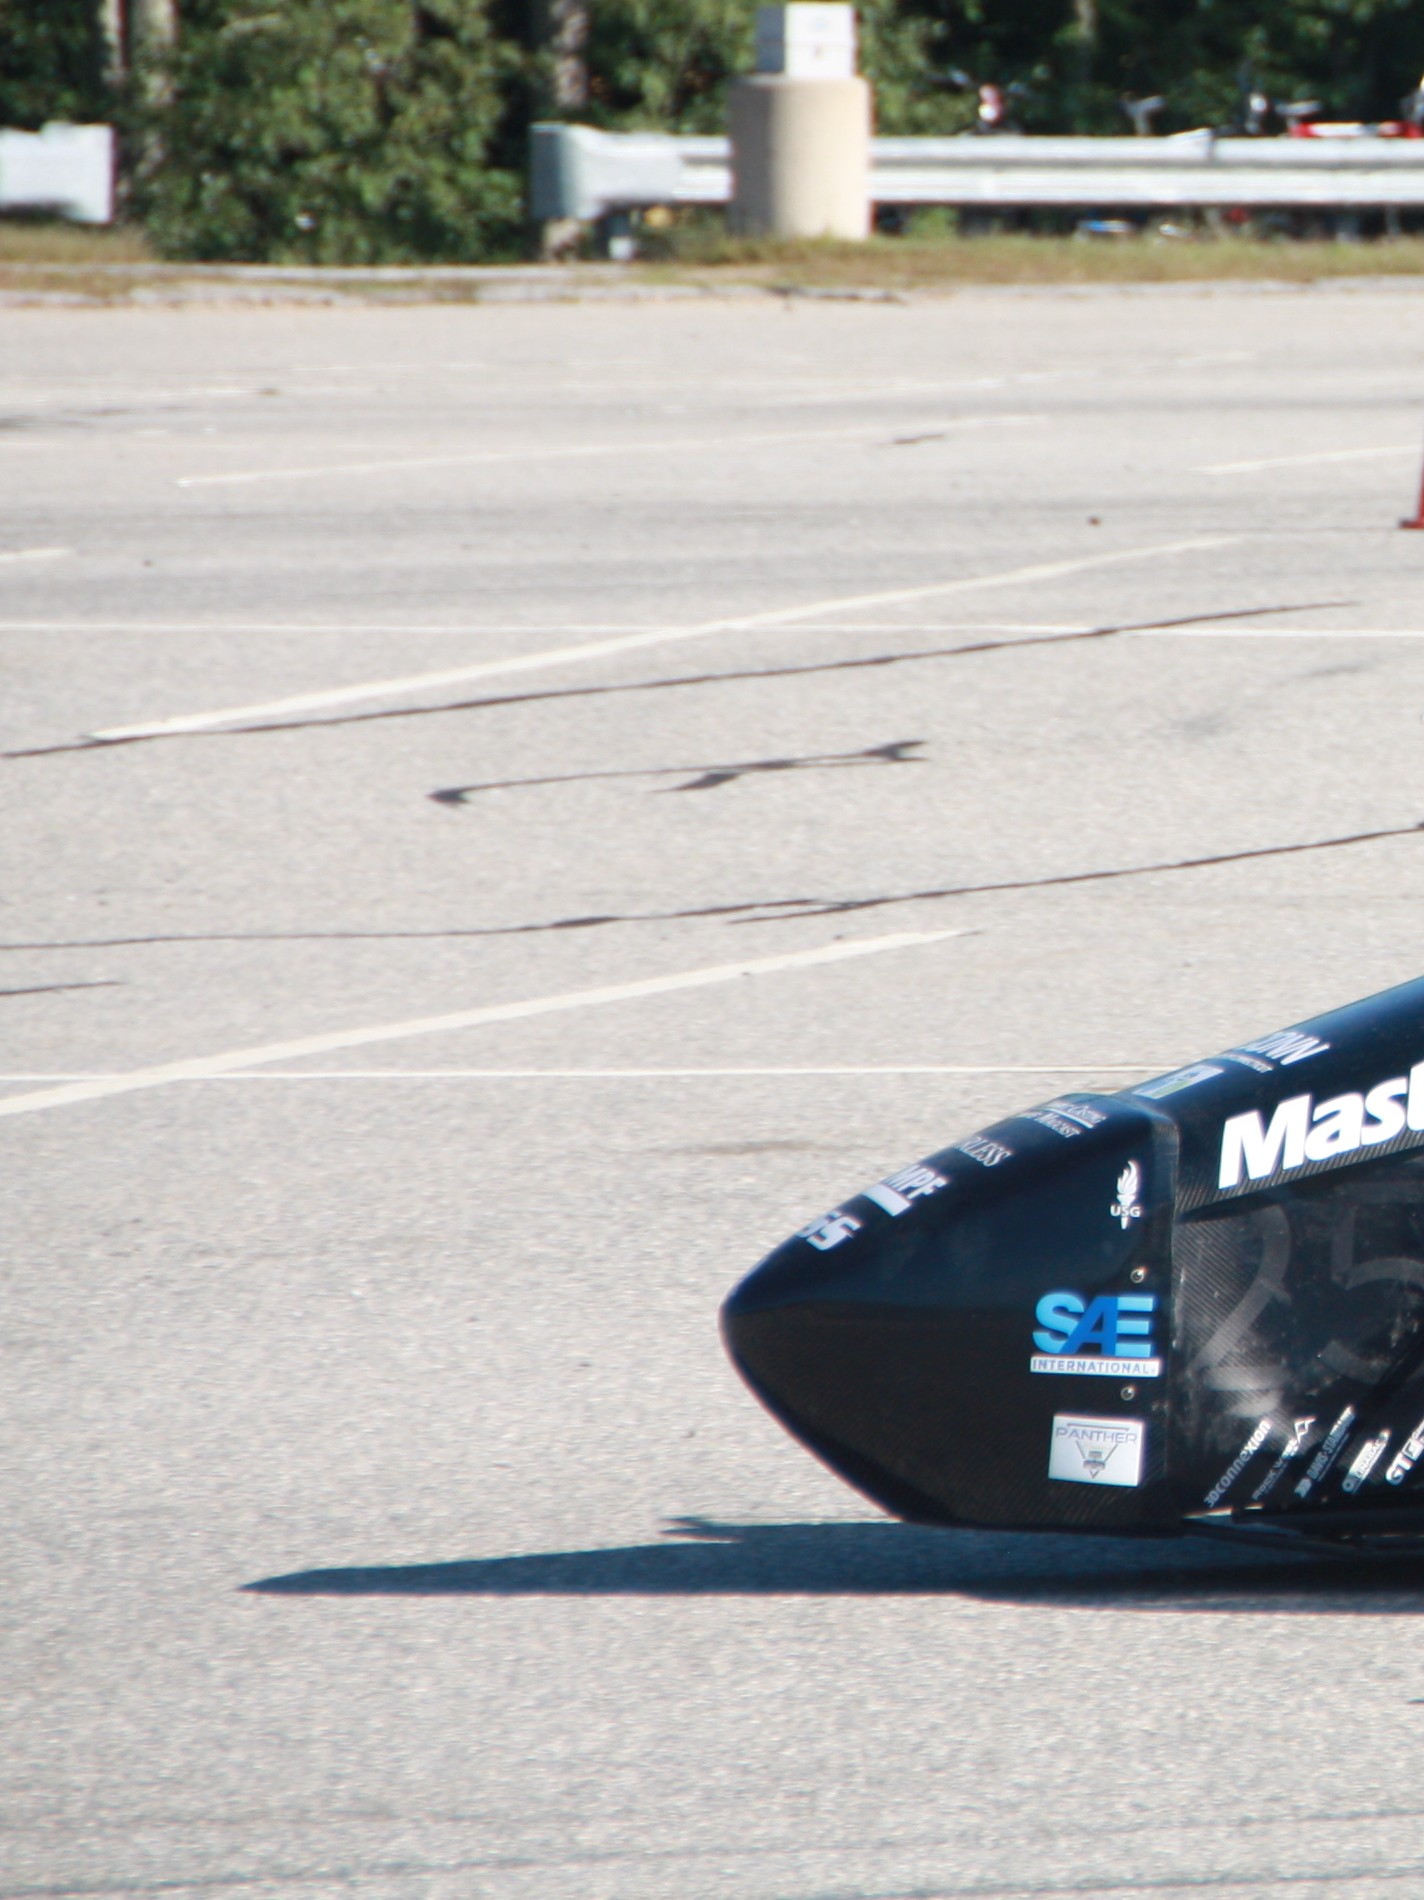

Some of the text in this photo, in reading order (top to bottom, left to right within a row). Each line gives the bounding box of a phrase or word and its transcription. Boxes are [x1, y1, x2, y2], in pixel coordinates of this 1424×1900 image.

[1110, 1204, 1142, 1219] USG
[1032, 1292, 1155, 1358] SAE
[1032, 1358, 1150, 1374] INTERNATIONAL
[1054, 1426, 1139, 1445] PANTHER
[1203, 1418, 1273, 1509] 3Dconnexion
